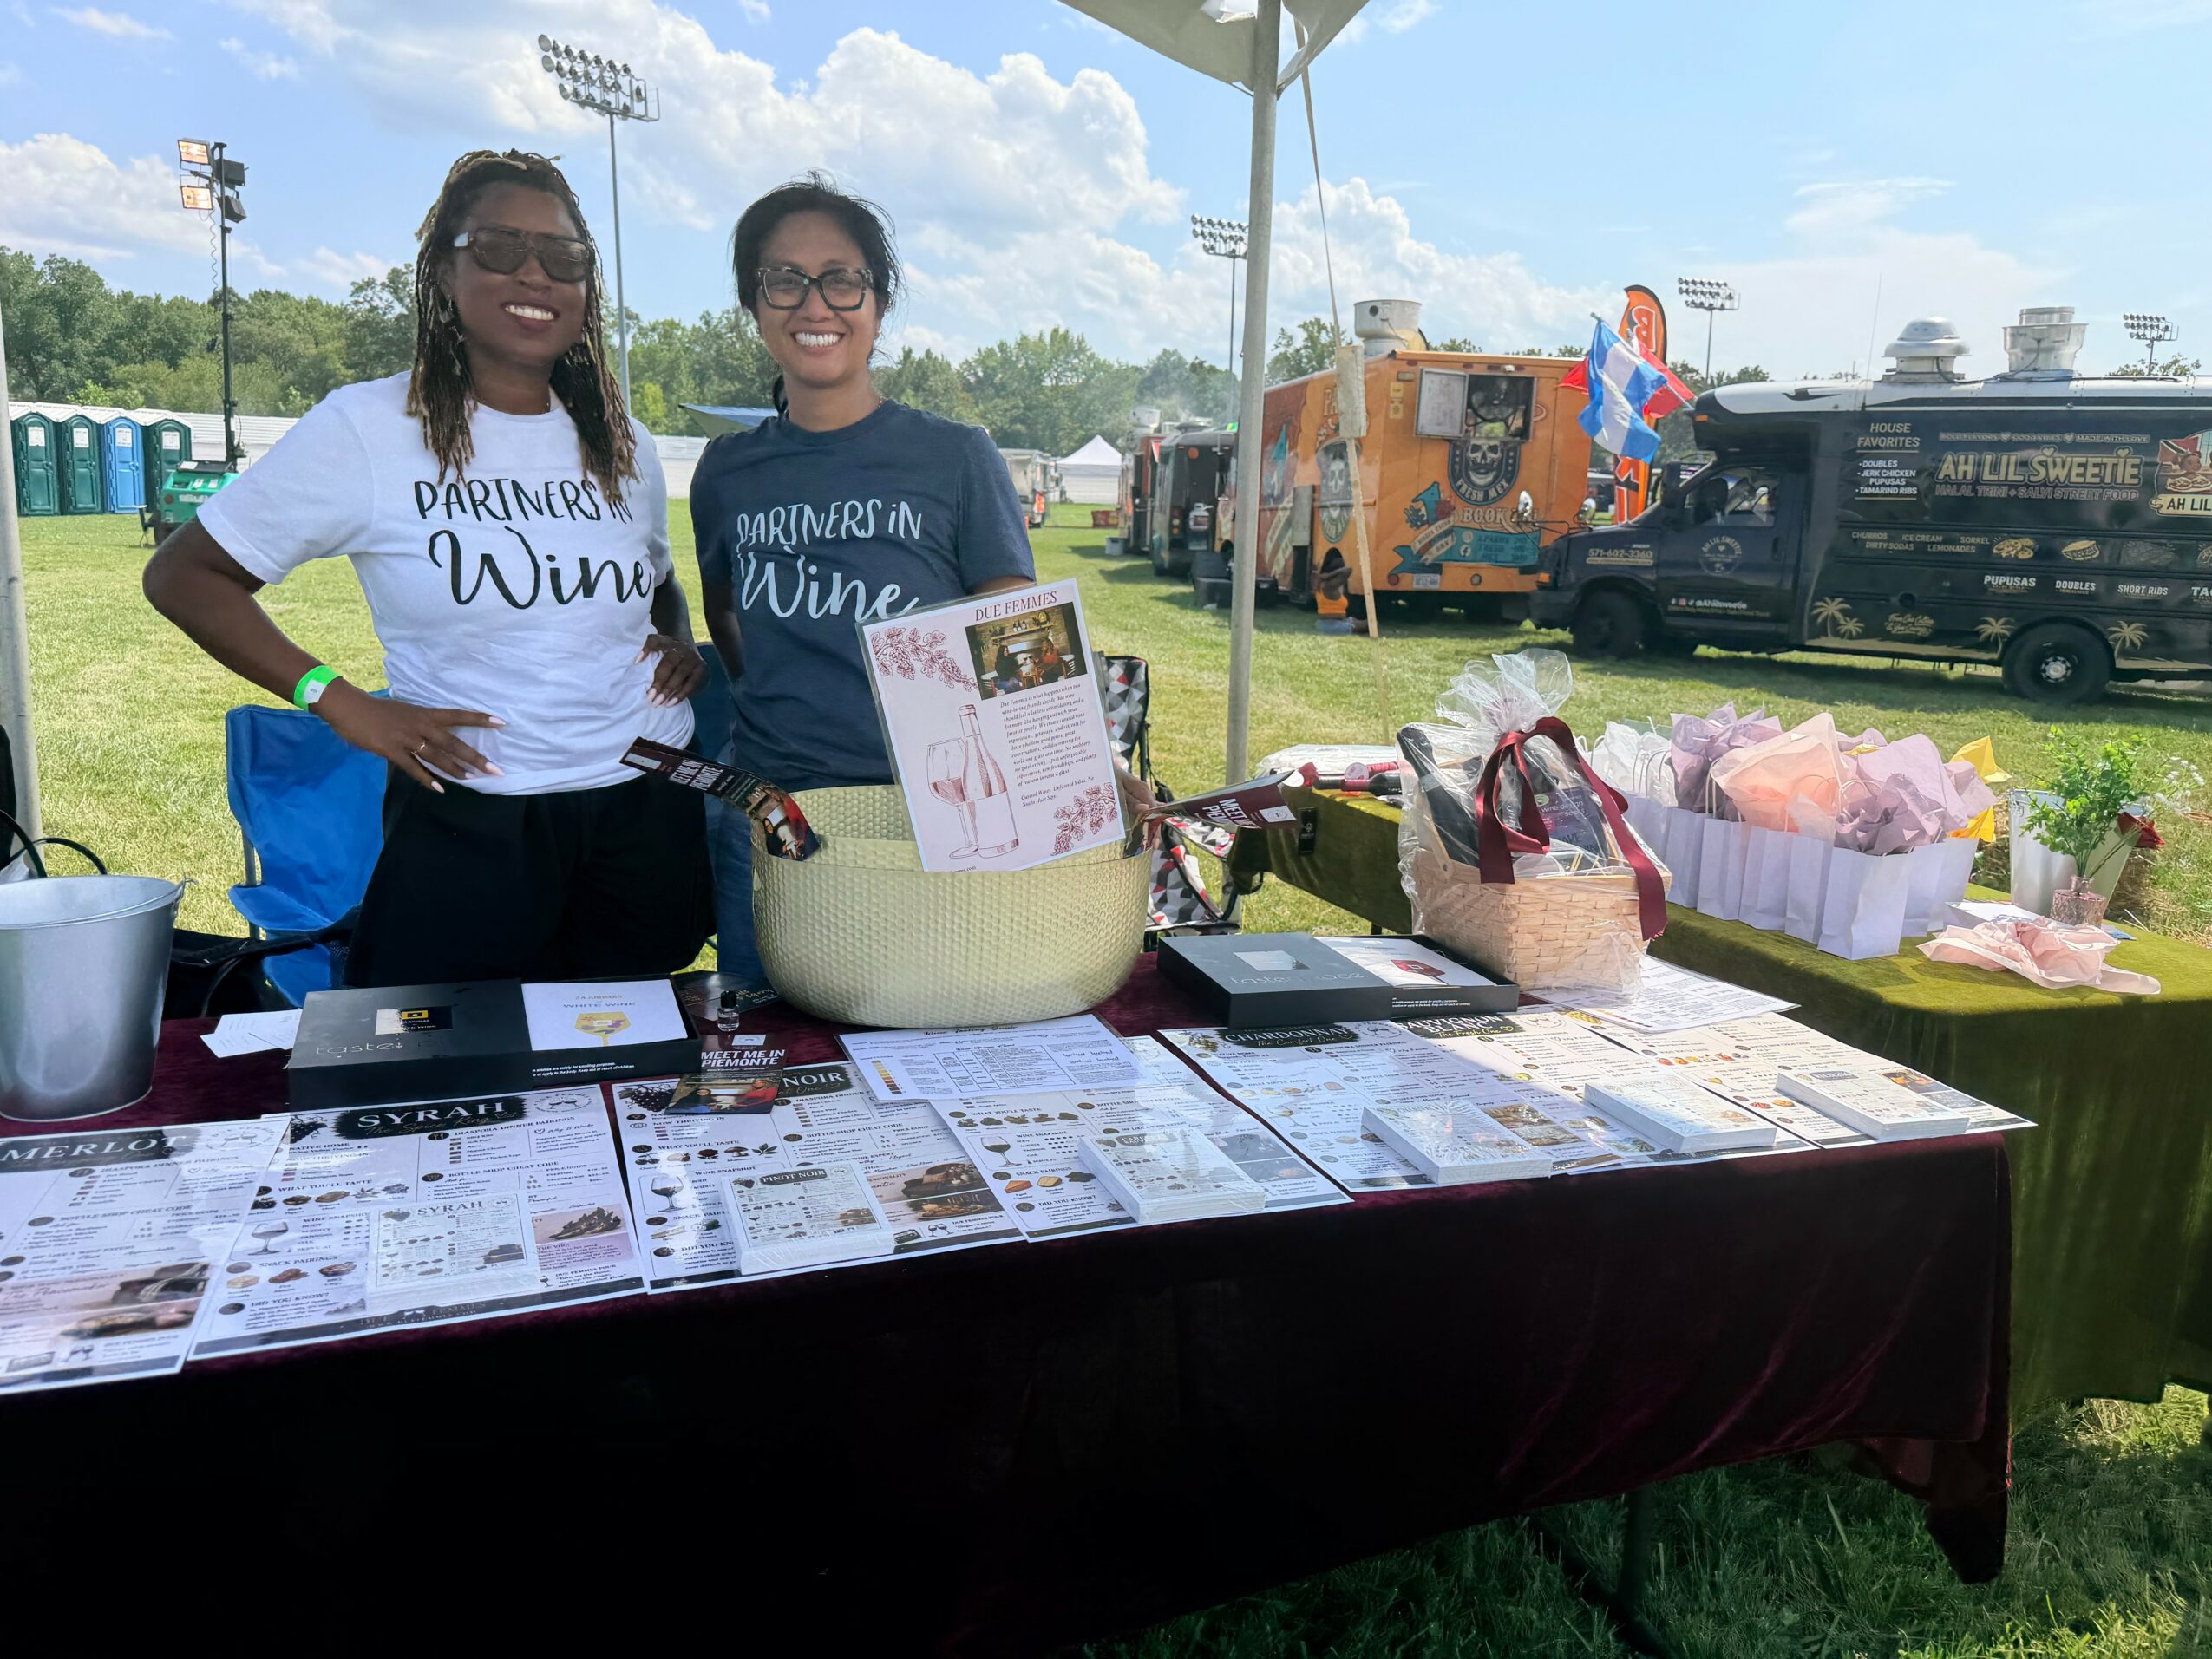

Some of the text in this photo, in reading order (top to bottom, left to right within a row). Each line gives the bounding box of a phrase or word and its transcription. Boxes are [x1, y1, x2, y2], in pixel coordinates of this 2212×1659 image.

[1870, 423, 1911, 433] HOUSE
[1857, 437, 1921, 447] FAVORITES
[1937, 451, 2143, 486] AH LIL SWEETIE
[1456, 479, 1509, 501] FRESH MEX
[1935, 485, 1974, 497] HALAL
[1977, 486, 2009, 497] TRINI
[2017, 487, 2052, 499] SALVI
[2054, 488, 2103, 500] STREET
[2103, 489, 2139, 501] FOOD
[414, 478, 601, 521] PARTNERS
[2167, 498, 2185, 510] AH
[736, 499, 882, 546] PARTNERS
[1710, 536, 1720, 545] LIL
[1722, 535, 1742, 555] SWEETIE
[1852, 532, 1888, 540] CHURROS
[1914, 534, 1942, 543] CREAM
[1960, 536, 1990, 545] SORREL
[1866, 541, 1976, 553] DIRTY SODAS LEMONADES
[428, 526, 651, 609] Wine
[736, 545, 919, 623] Wine
[1984, 575, 2168, 596] PUPUSAS DOUBLES SHORT RIBS
[974, 591, 1058, 622] DUE FEMMES
[1009, 696, 1027, 705] Femmes
[563, 1001, 601, 1009] WHITE
[1225, 1027, 1349, 1041] CHARDONNAY
[1423, 1022, 1493, 1033] BLANC
[700, 1048, 785, 1061] MEET ME IN
[701, 1055, 778, 1069] PIEMONTE
[782, 1071, 845, 1087] NOIR
[357, 1099, 506, 1128] SYRAH
[454, 1115, 575, 1136] DIASPORA DINNER PAIRINGS
[1, 1133, 189, 1163] MERLOT
[448, 1169, 481, 1179] BOTTLE
[762, 1169, 826, 1182] PINOT NOIR
[1040, 1166, 1072, 1174] PAIRINGS
[277, 1185, 307, 1194] WHAT
[344, 1178, 372, 1186] TASTE
[1070, 1192, 1096, 1203] KNOW?
[417, 1199, 484, 1218] SYRAH
[259, 1253, 337, 1269] SNACK PAIRINGS
